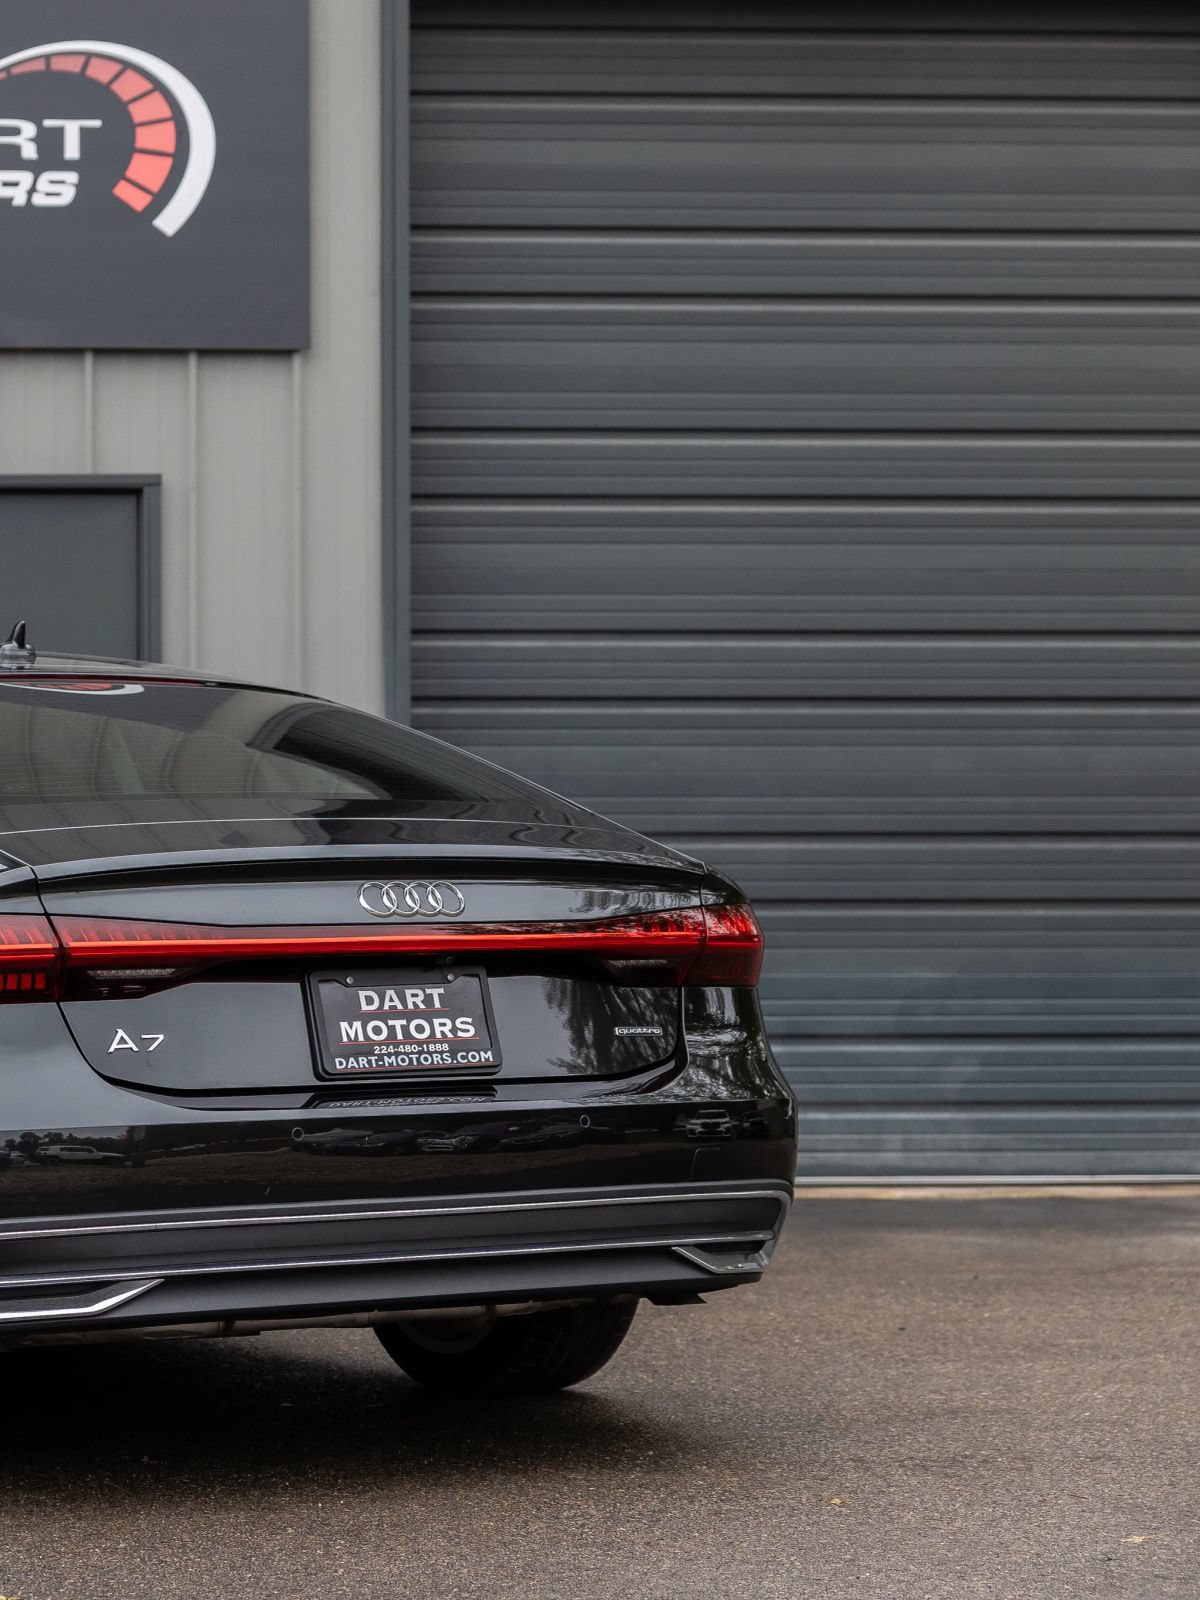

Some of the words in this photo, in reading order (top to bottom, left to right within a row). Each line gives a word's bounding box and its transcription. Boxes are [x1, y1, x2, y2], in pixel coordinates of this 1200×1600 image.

[358, 988, 444, 1011] DART
[339, 1017, 475, 1042] MOTORS
[618, 1027, 661, 1035] quattro
[107, 1028, 165, 1053] A7
[373, 1043, 450, 1054] 224-480-1888
[335, 1051, 493, 1069] DART-MOTORS.COM
